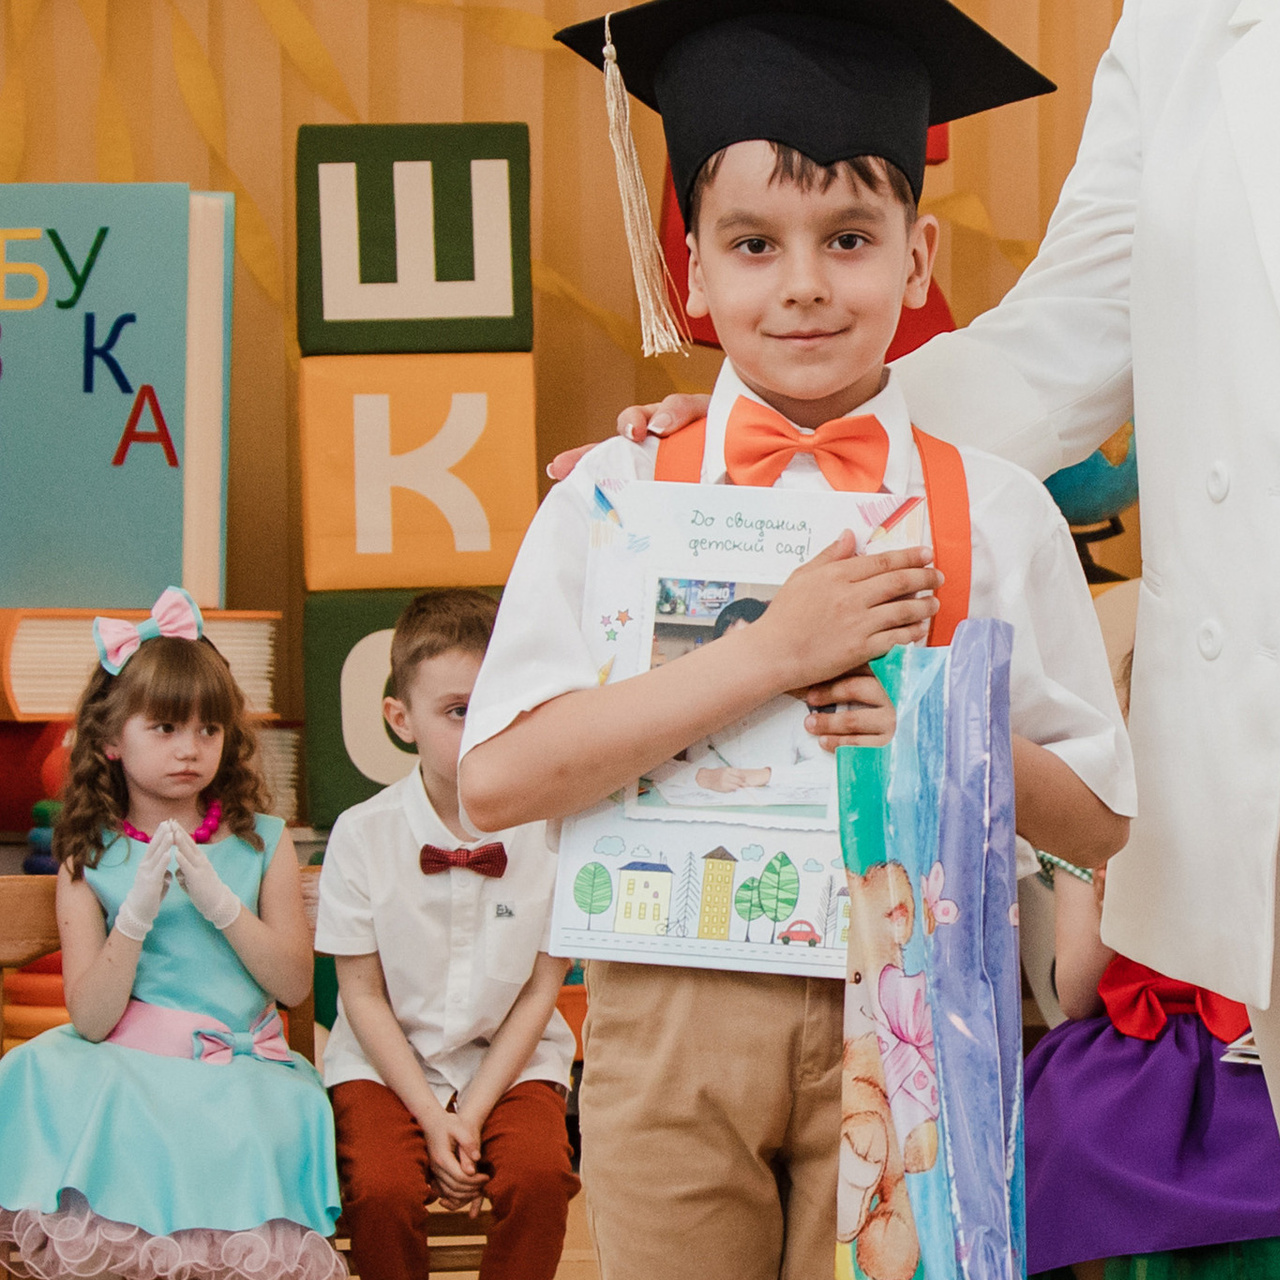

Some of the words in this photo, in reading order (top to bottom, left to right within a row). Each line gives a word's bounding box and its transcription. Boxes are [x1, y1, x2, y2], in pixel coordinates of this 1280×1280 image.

[317, 158, 515, 321] Ш
[690, 509, 715, 527] До
[725, 511, 812, 537] свидания,
[688, 537, 765, 557] детский
[775, 536, 812, 563] сад!
